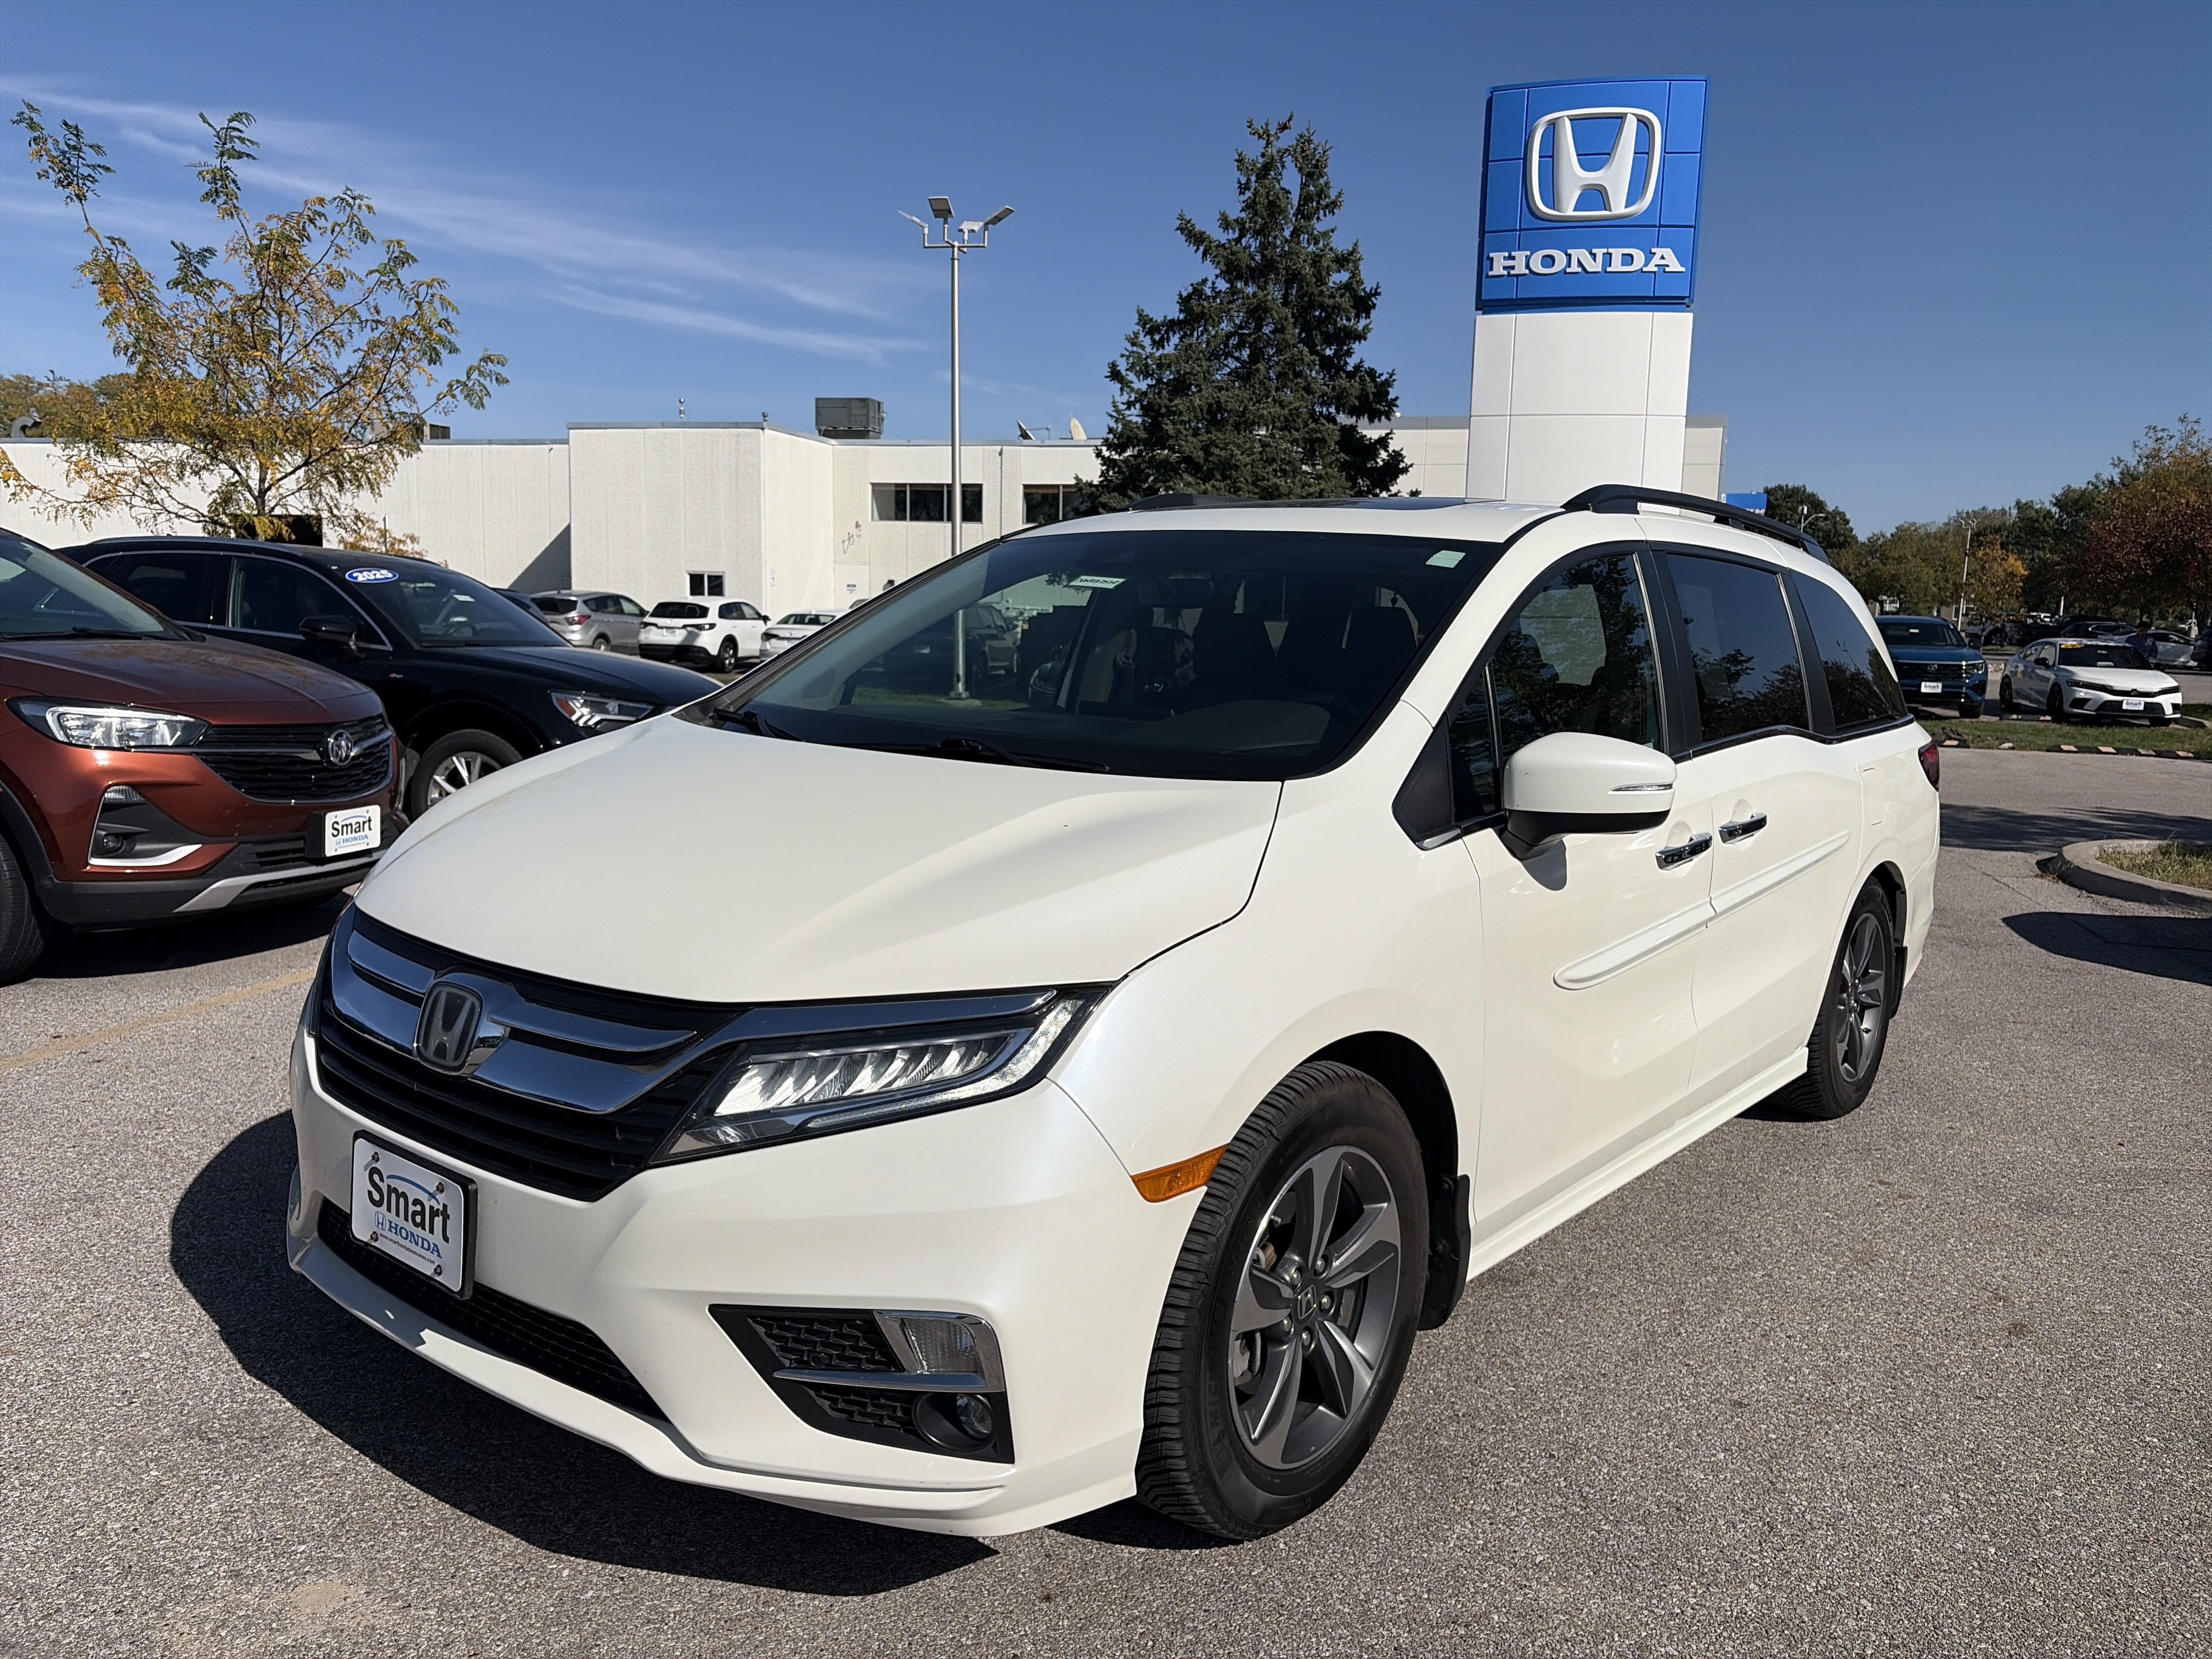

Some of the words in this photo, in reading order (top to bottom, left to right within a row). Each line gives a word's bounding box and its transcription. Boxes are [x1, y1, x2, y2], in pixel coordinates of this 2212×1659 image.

[1488, 247, 1685, 276] HONDA
[352, 569, 393, 582] 2025
[331, 816, 372, 837] Smart
[342, 834, 369, 844] HONDA
[367, 1166, 450, 1243] Smart
[387, 1219, 442, 1260] HONDA
